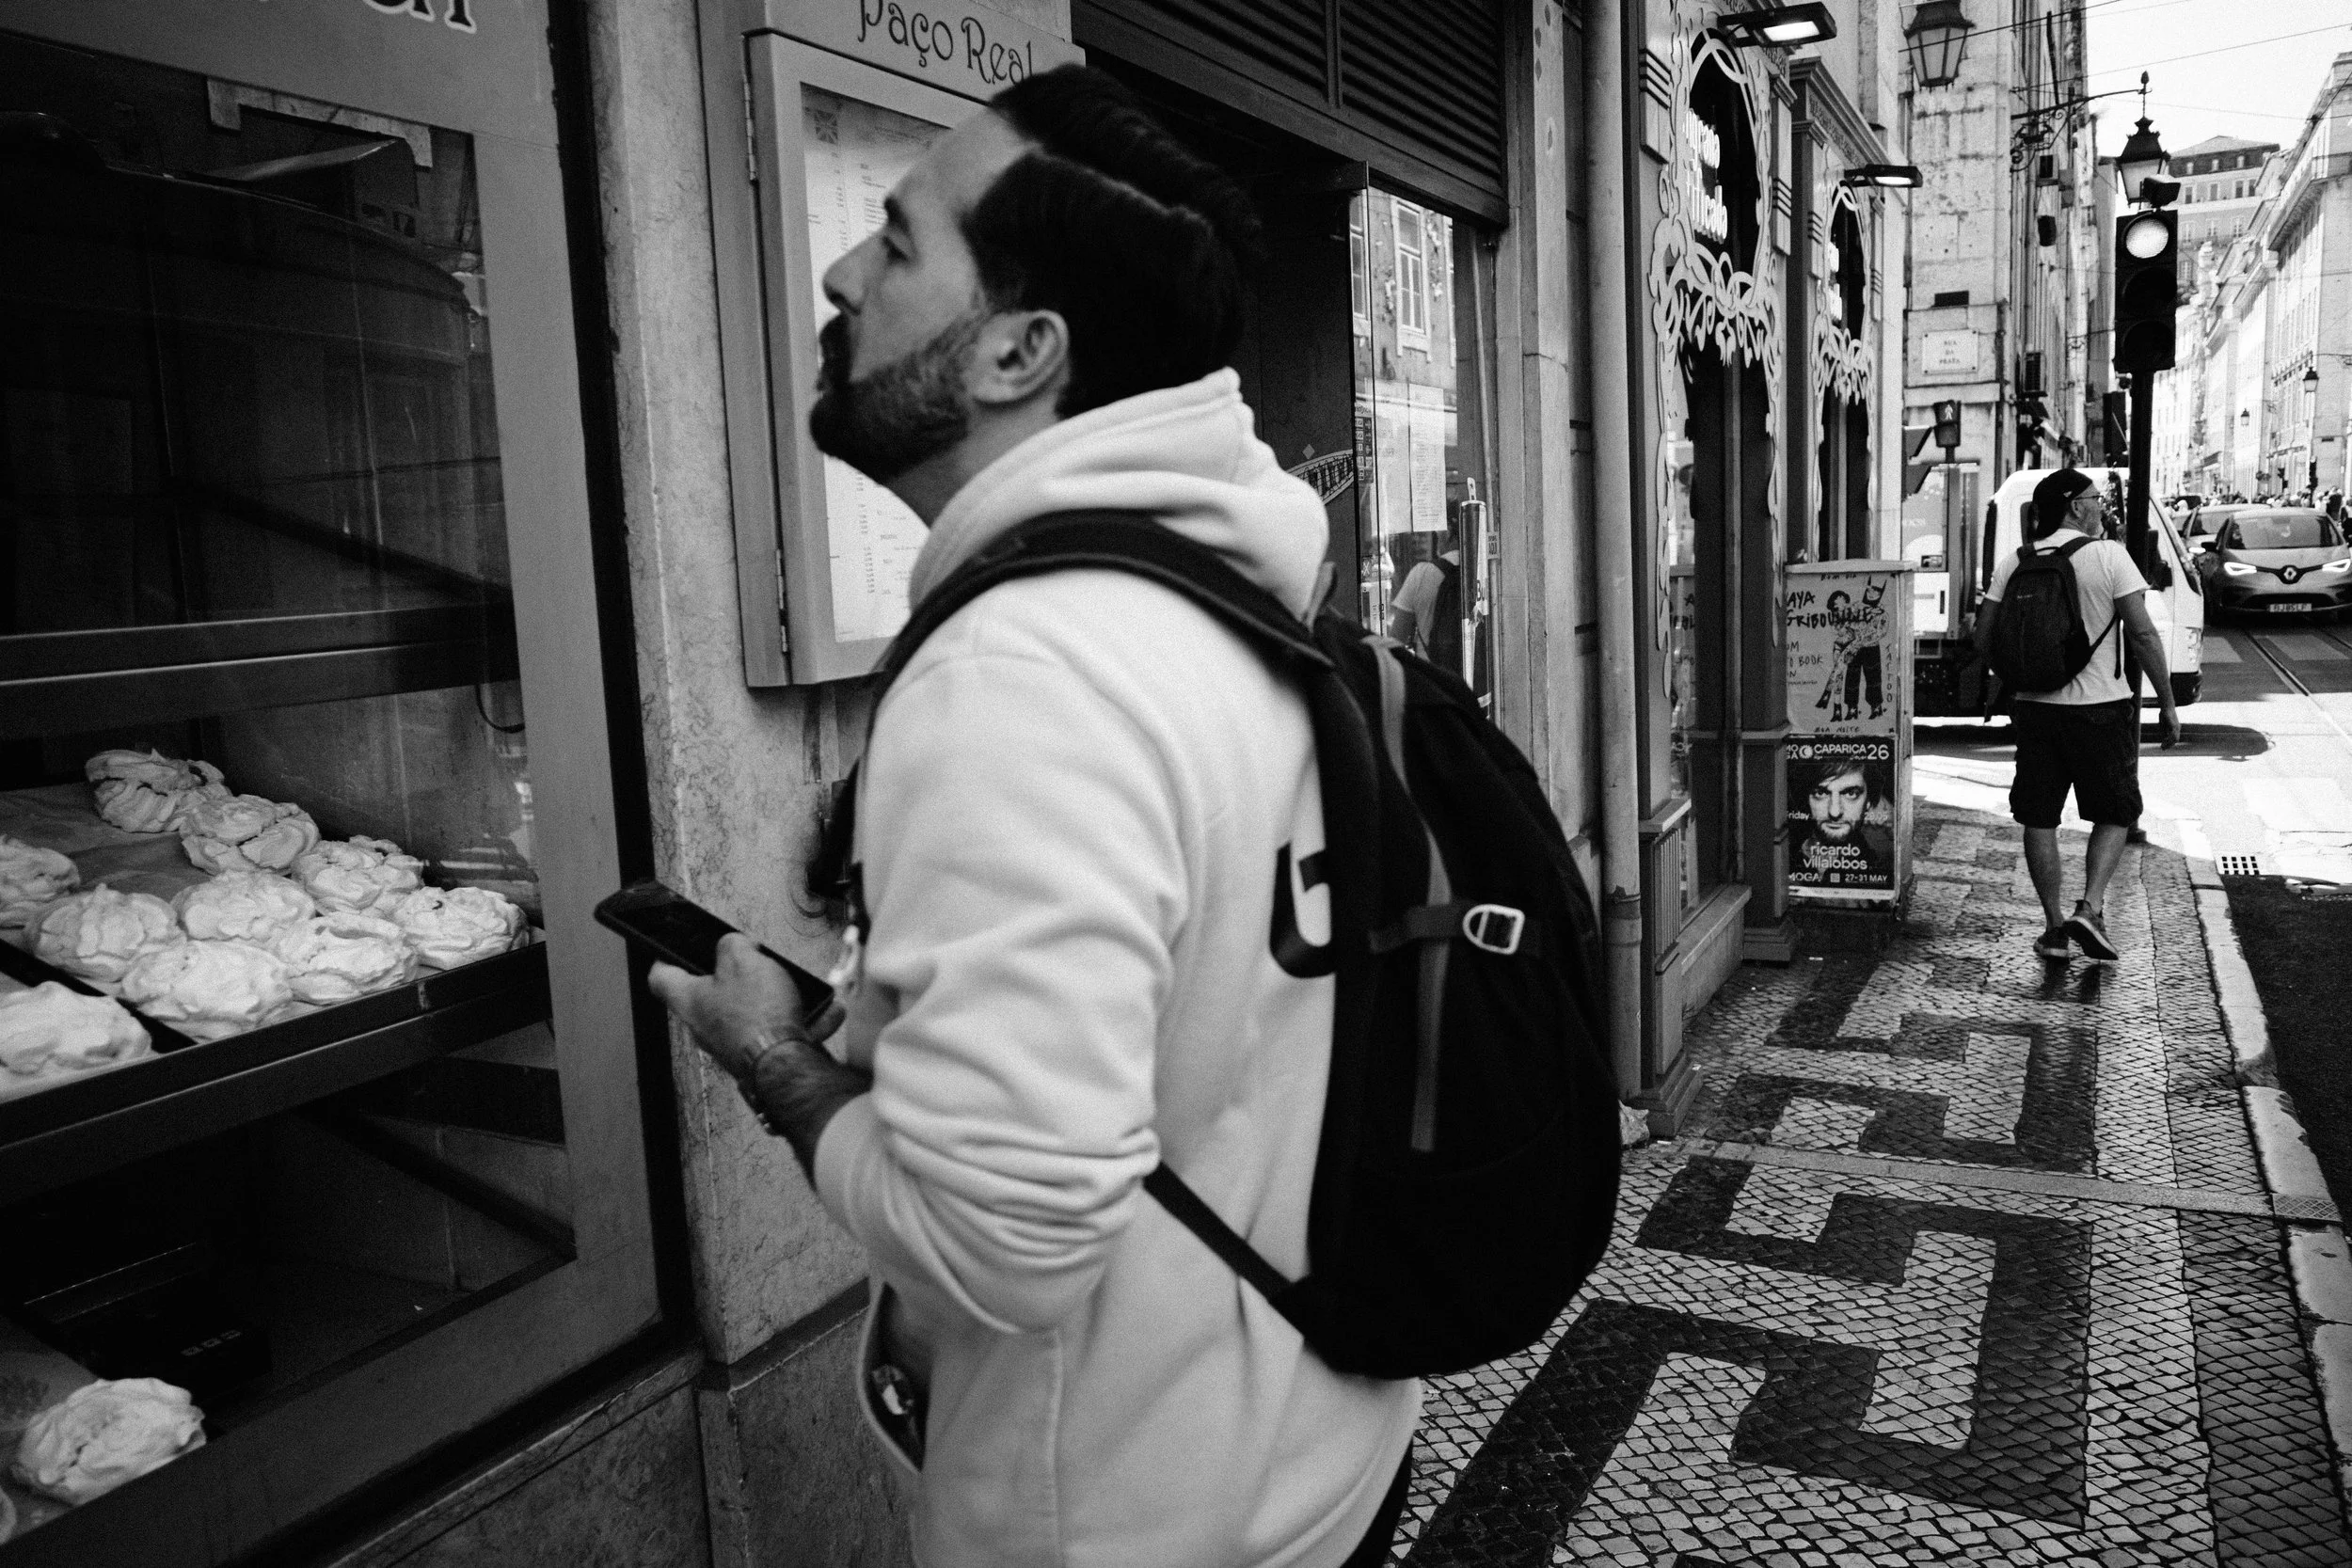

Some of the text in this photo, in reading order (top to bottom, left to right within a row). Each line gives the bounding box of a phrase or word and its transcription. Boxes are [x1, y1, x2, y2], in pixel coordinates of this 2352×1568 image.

[858, 0, 1033, 85] Paço Real
[1787, 590, 1816, 610] AYA
[1799, 654, 1824, 668] BOOK
[1813, 743, 1890, 761] CAPARICA 26
[1787, 809, 1810, 821] riday
[1810, 842, 1860, 856] ricardo
[1803, 855, 1868, 871] villalobos
[1868, 874, 1888, 882] MAY
